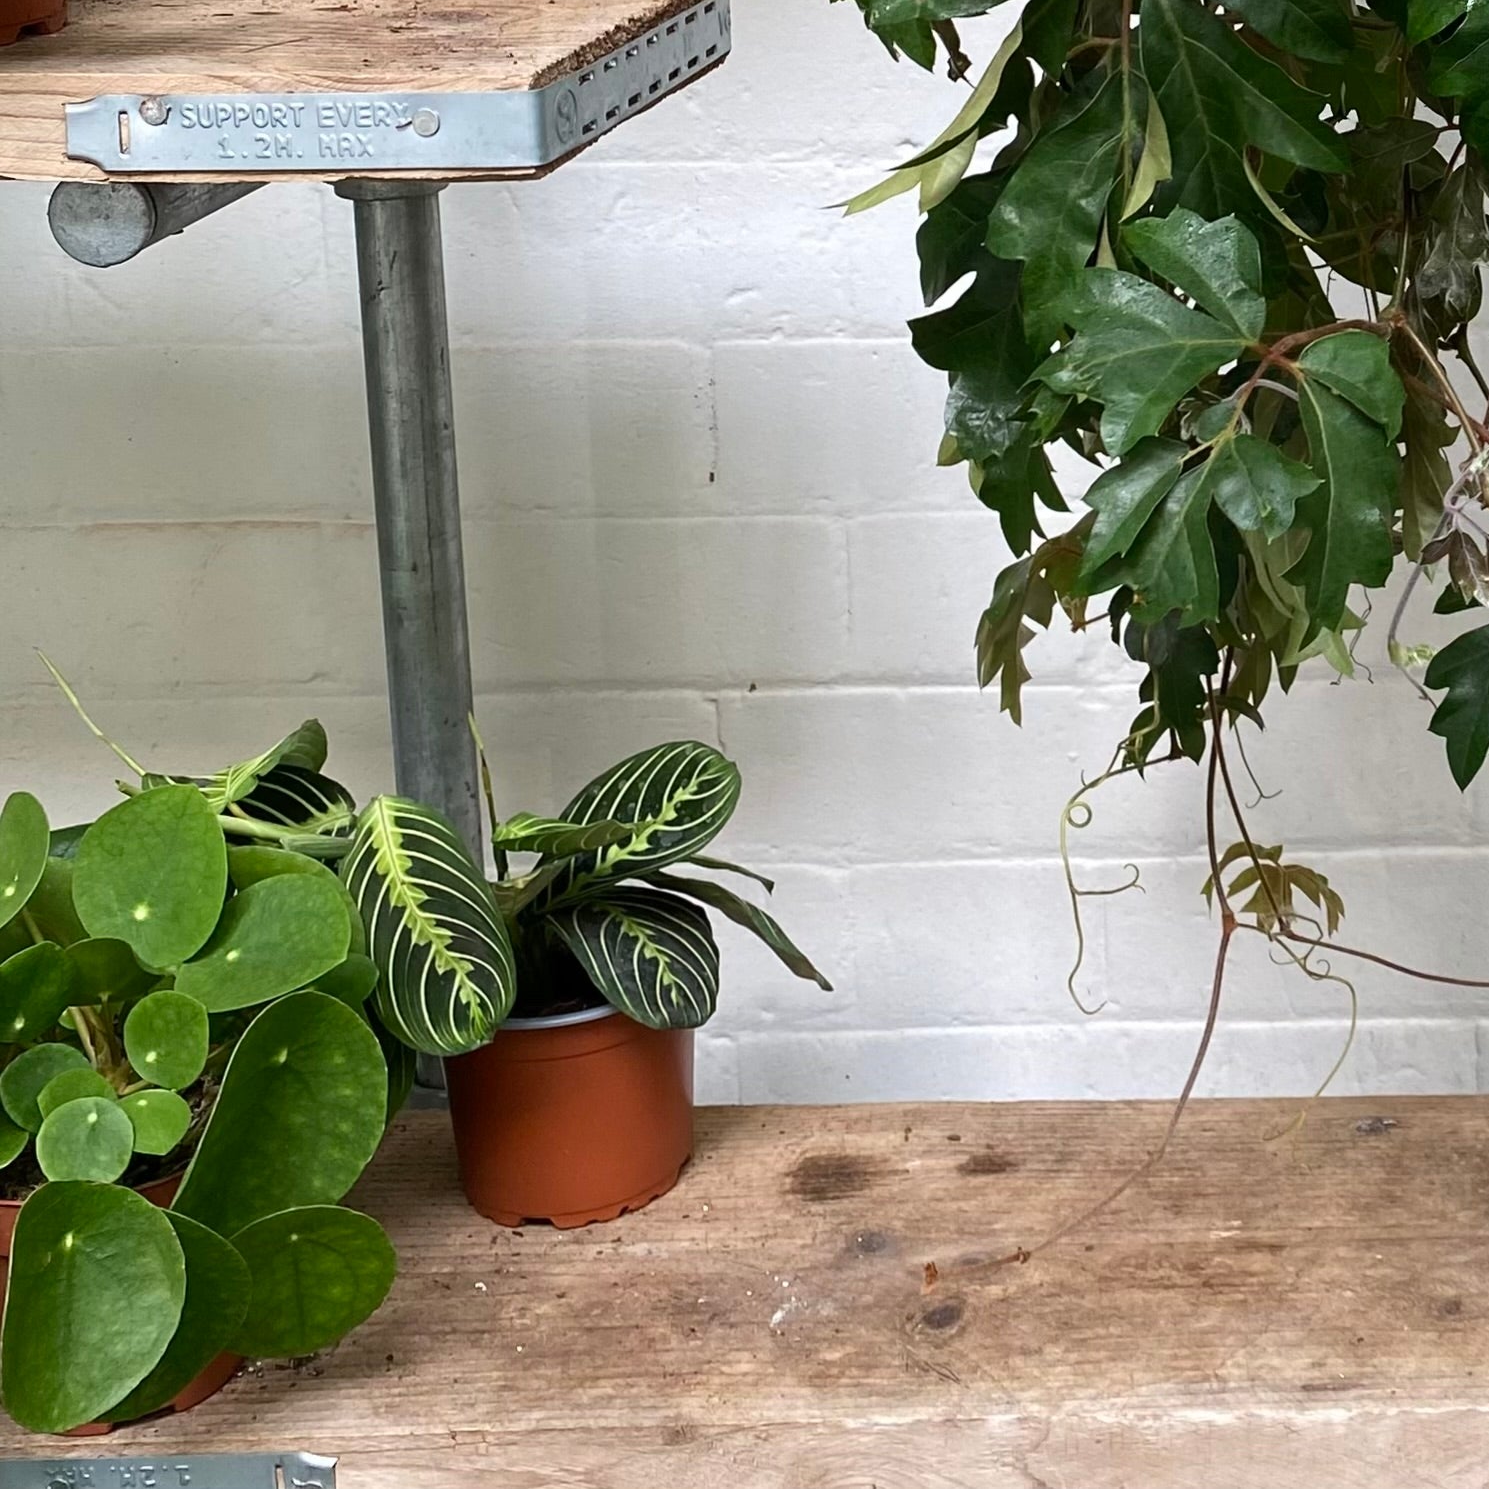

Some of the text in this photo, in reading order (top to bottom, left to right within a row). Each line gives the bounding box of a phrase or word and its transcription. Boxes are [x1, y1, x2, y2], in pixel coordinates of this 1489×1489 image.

[180, 101, 409, 129] SUPPORT EVERY
[318, 133, 375, 158] MAX
